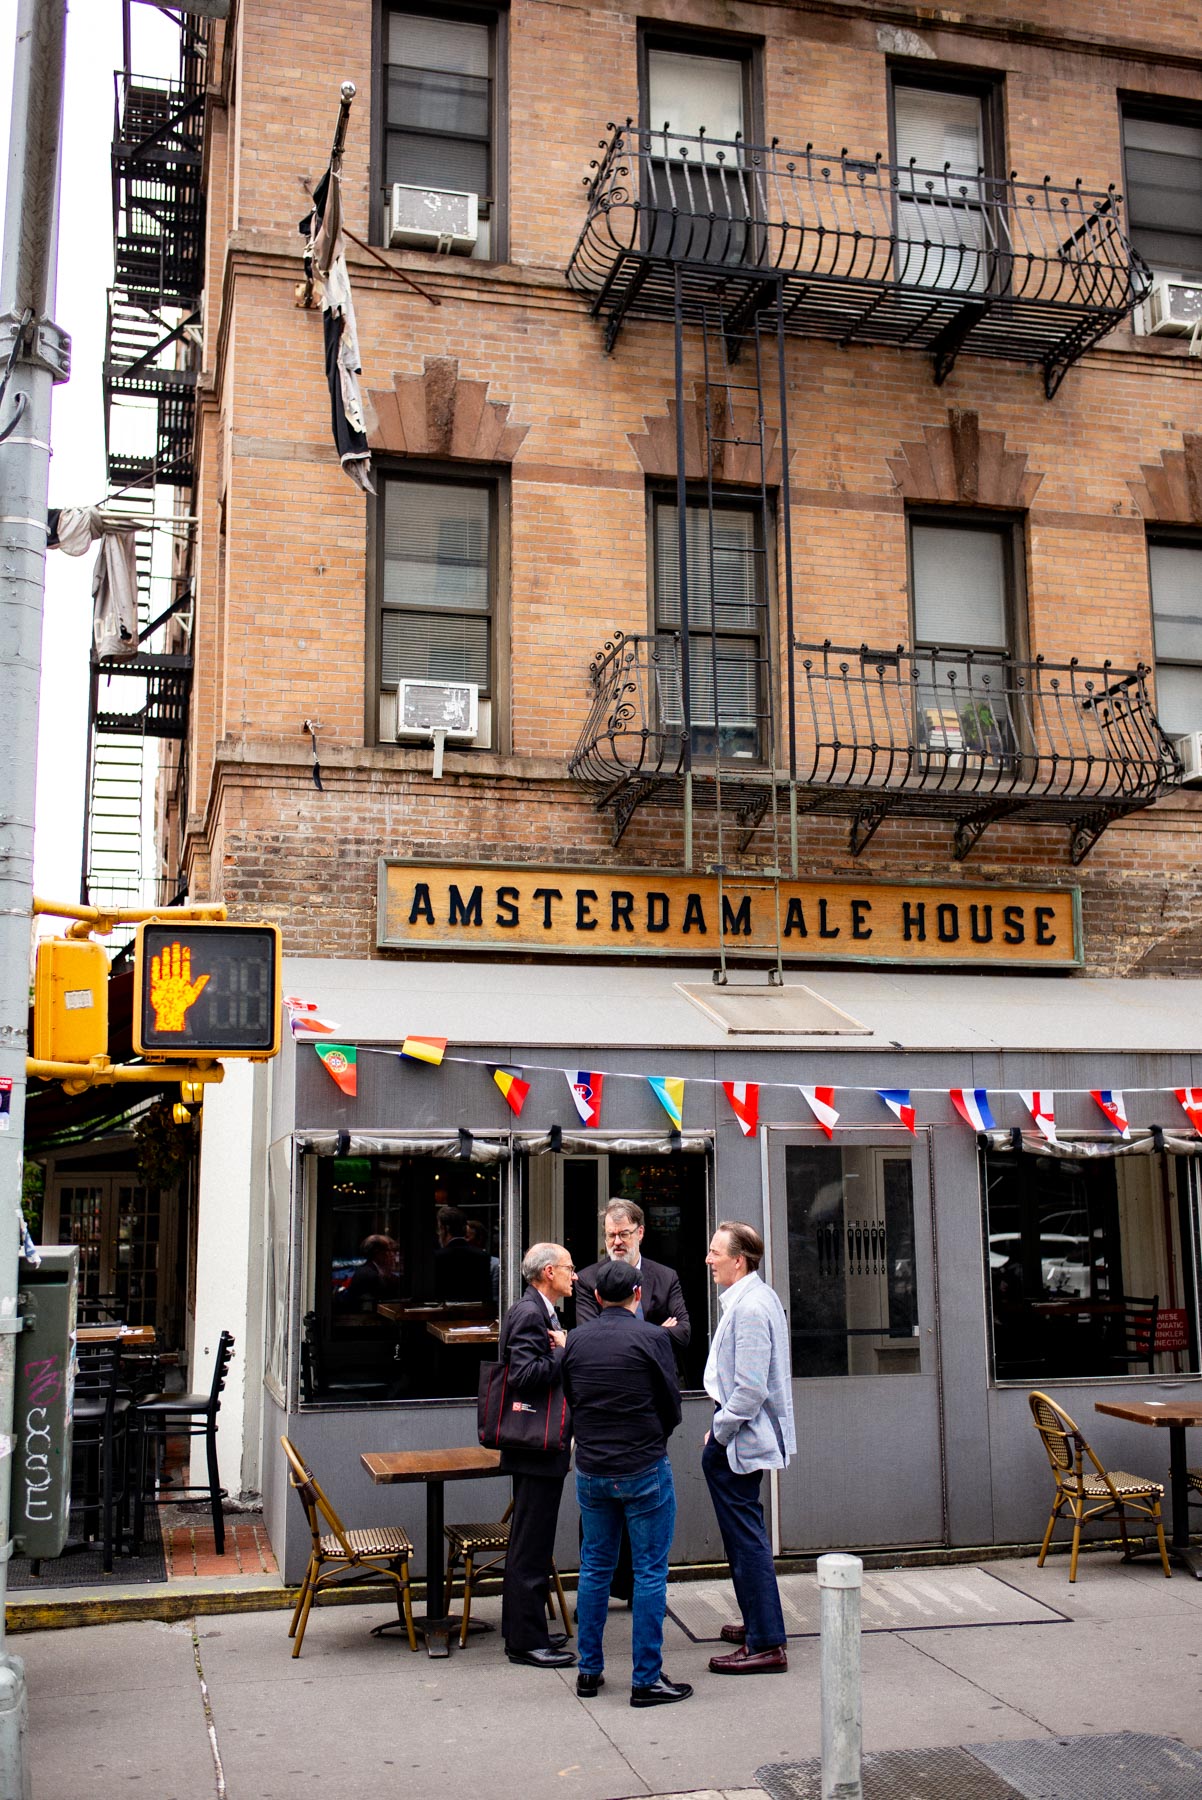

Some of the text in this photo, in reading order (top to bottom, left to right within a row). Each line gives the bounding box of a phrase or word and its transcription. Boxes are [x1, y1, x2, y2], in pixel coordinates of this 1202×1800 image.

[408, 882, 1057, 946] AMSTERDAM ALE HOUSE
[1142, 1330, 1184, 1338] SINKLER
